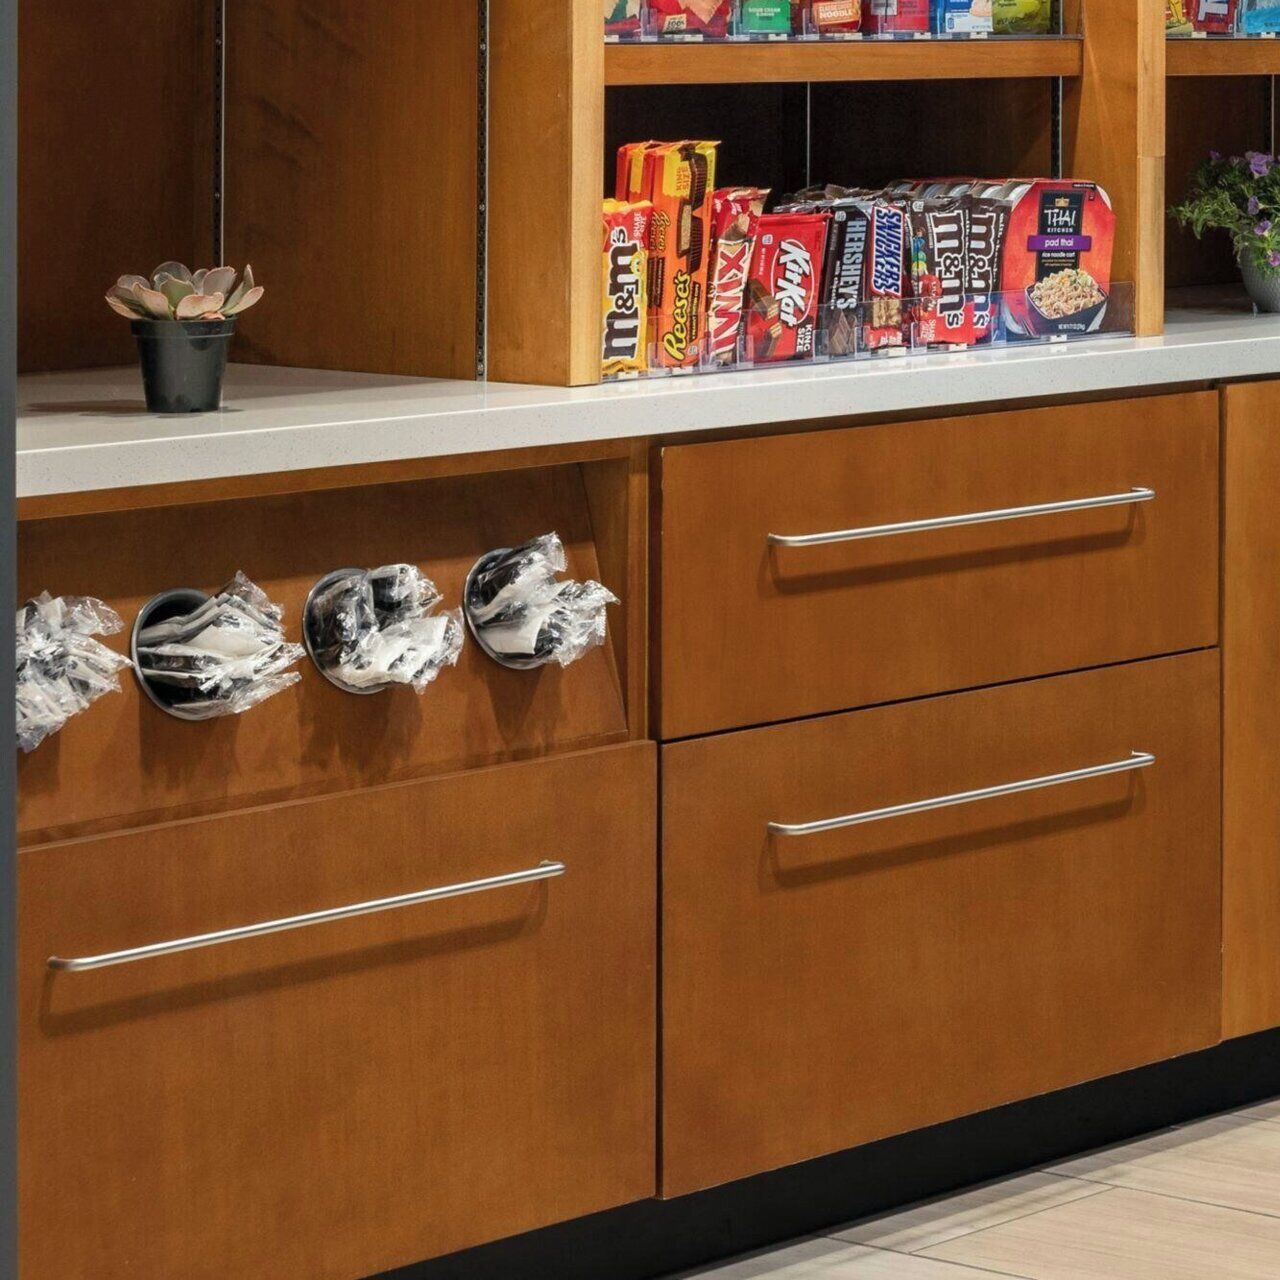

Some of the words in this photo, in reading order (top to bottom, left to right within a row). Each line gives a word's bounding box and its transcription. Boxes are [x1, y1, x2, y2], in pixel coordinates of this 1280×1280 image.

[1044, 209, 1076, 226] THAI
[1045, 239, 1059, 248] pad
[1061, 238, 1074, 246] thai
[837, 220, 867, 311] HERSHEY'S
[663, 269, 691, 360] Reese's
[803, 323, 812, 352] KING
